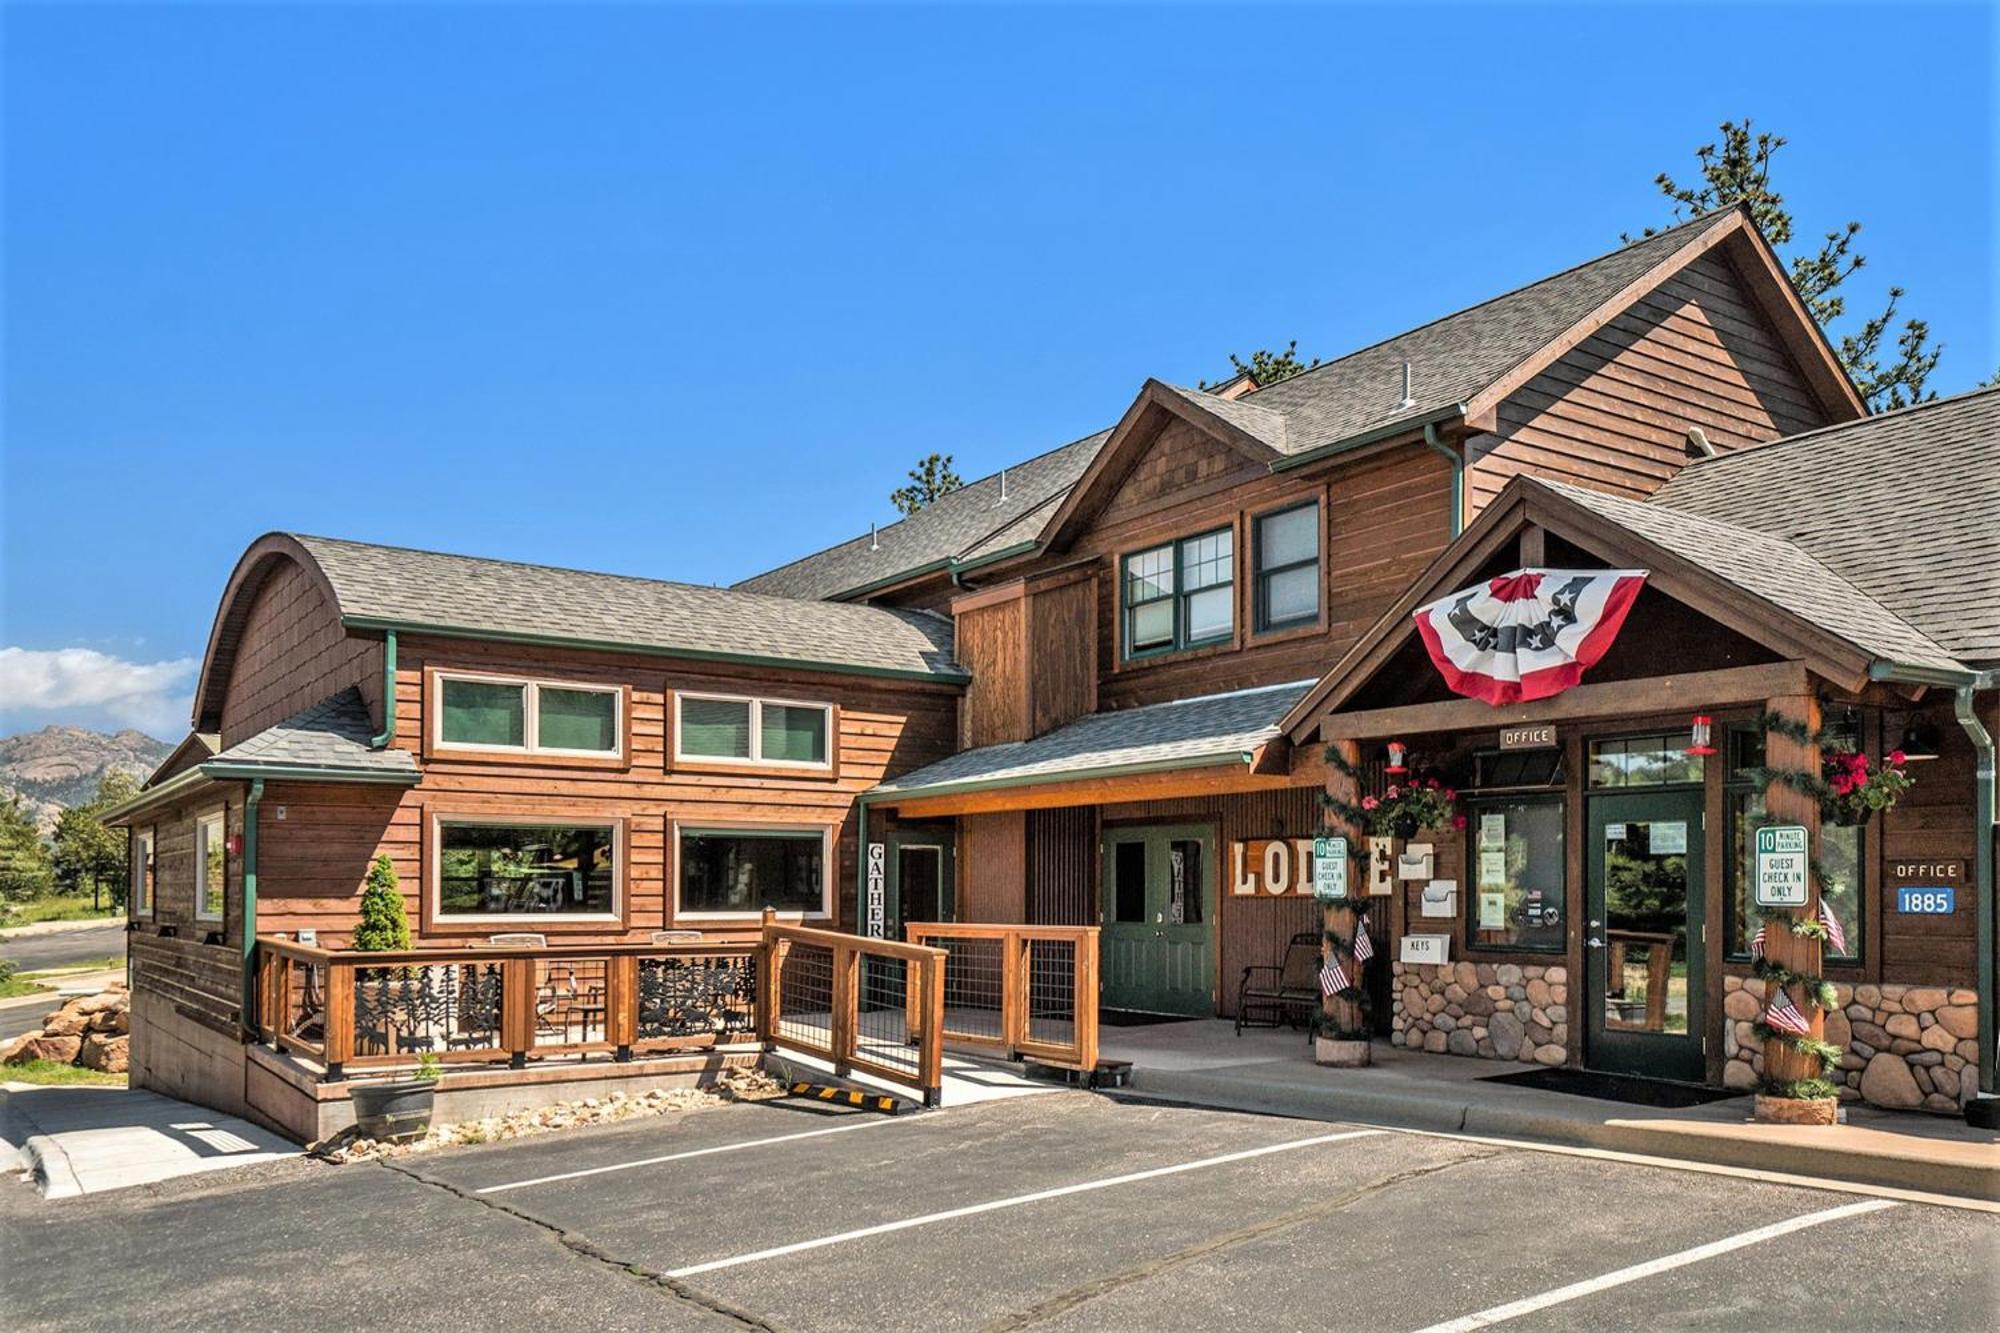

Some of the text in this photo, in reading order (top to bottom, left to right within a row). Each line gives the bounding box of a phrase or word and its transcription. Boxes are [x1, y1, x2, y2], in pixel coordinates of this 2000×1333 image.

[1506, 730, 1549, 745] OFFICE
[1760, 832, 1774, 850] 10
[1779, 832, 1801, 840] MINUTE
[1316, 842, 1325, 856] 10
[1777, 841, 1802, 849] PARKING
[1234, 837, 1392, 895] LODE
[1769, 859, 1793, 869] GUEST
[1897, 865, 1957, 877] OFFICE
[1763, 872, 1802, 883] CHECK IN
[869, 845, 883, 937] GATHER
[1770, 886, 1792, 897] ONLY
[1904, 893, 1948, 913] 1885
[1411, 940, 1430, 951] KEYS
